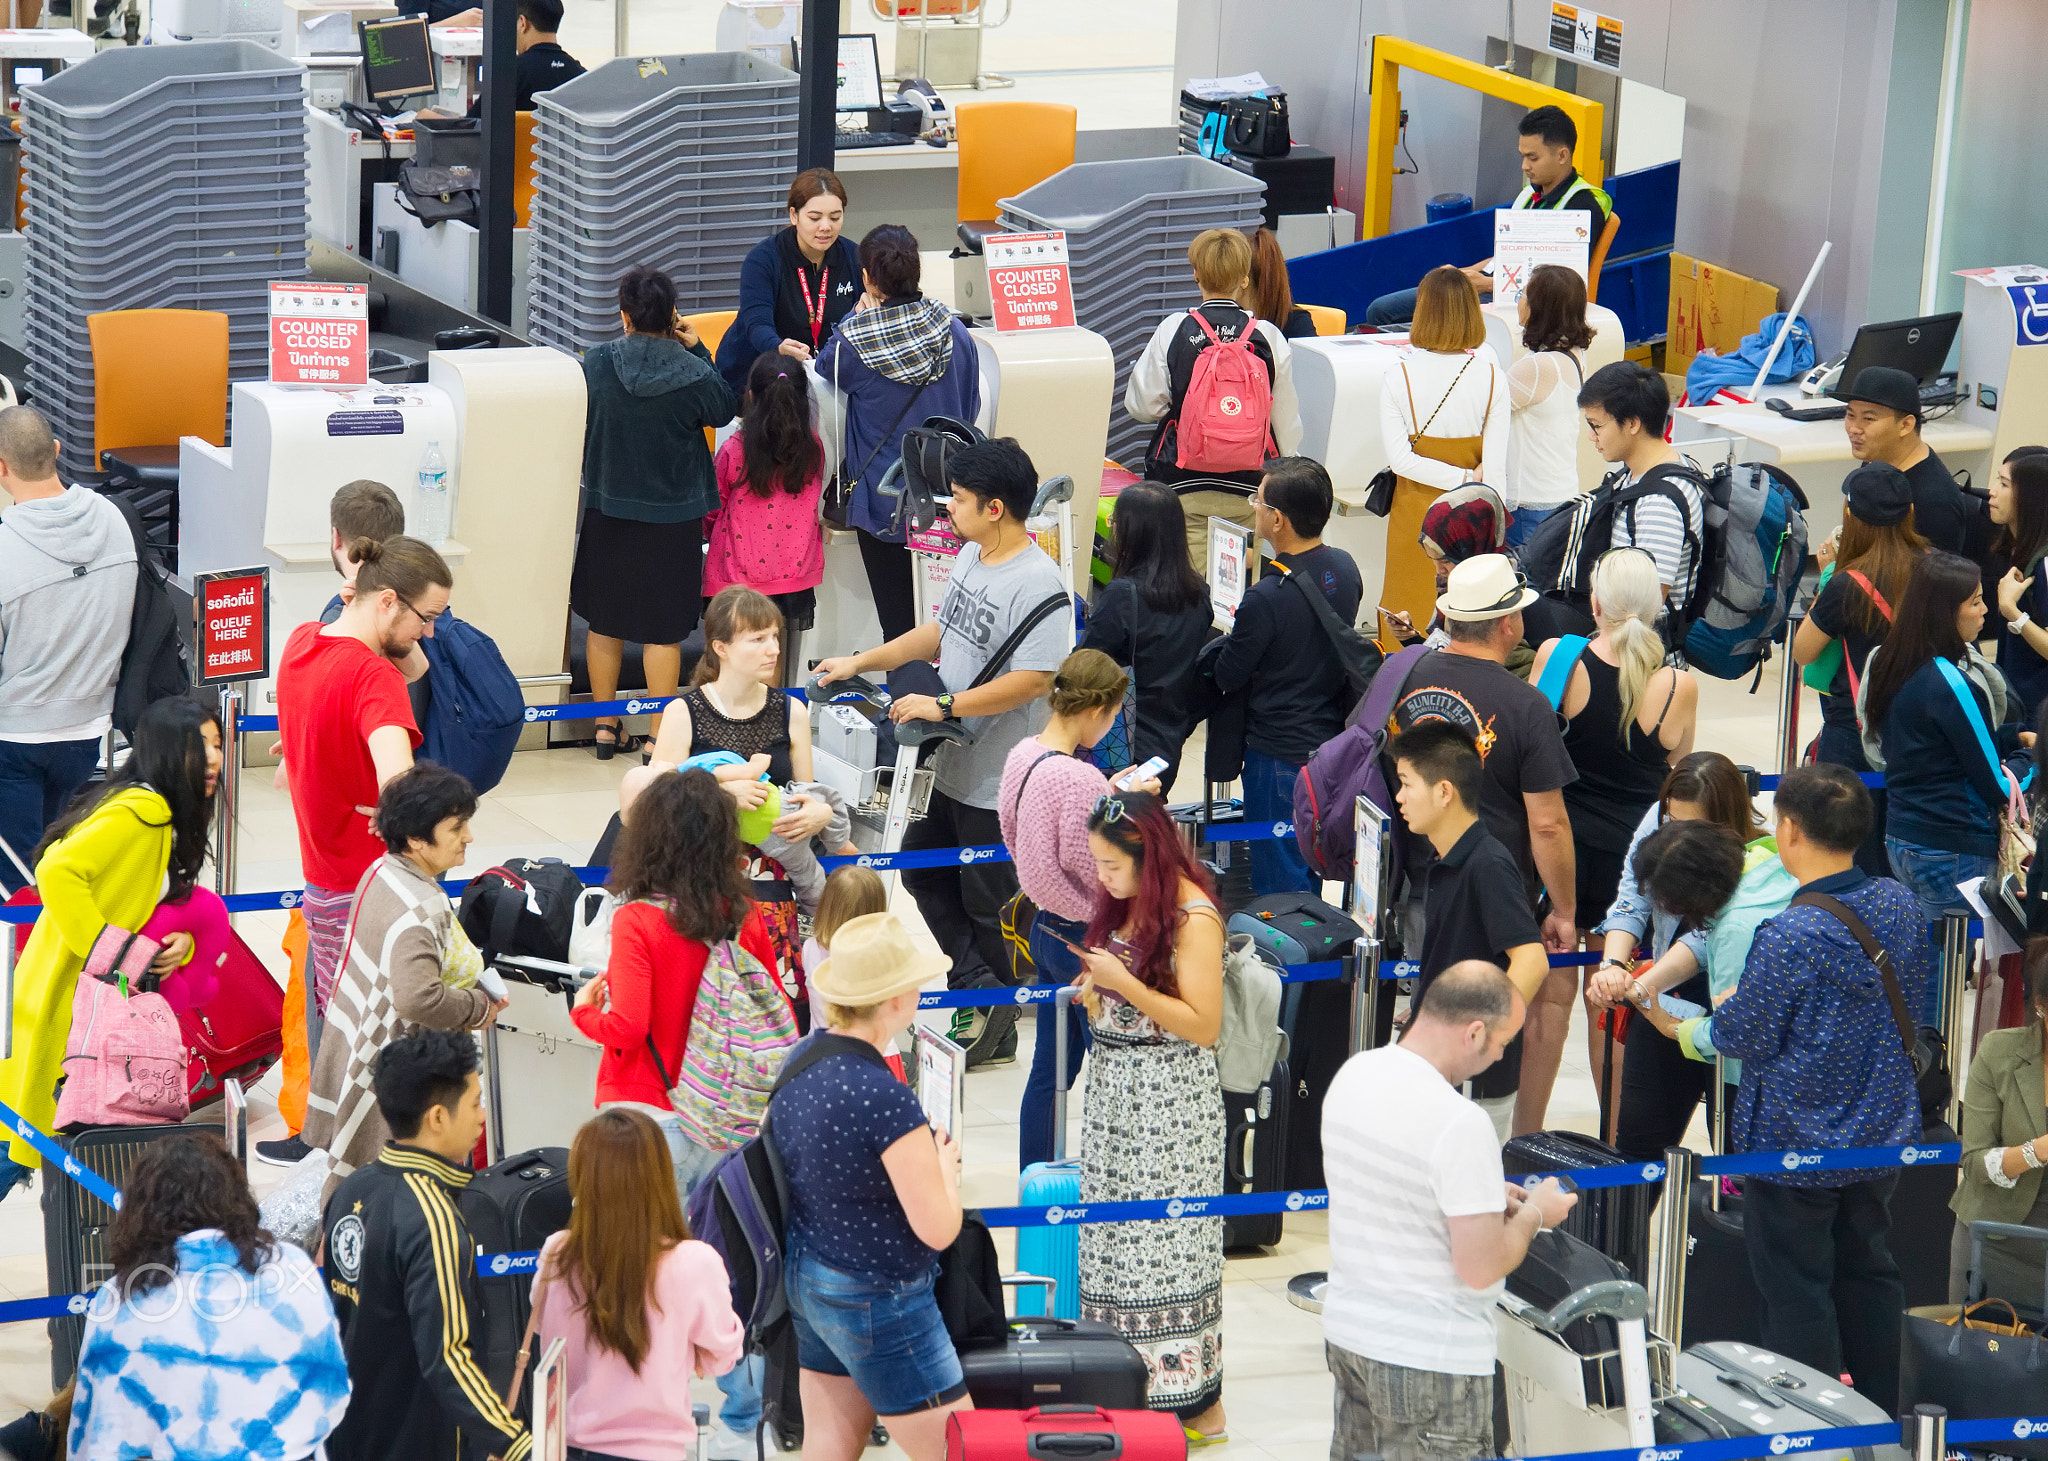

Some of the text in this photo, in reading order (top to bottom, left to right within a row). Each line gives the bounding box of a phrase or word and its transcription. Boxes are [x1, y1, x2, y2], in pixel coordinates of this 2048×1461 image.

[996, 268, 1061, 284] COUNTER
[1004, 282, 1057, 297] CLOSED
[1007, 298, 1058, 314] ปิดทำการ
[280, 321, 358, 336] COUNTER
[286, 335, 351, 349] CLOSED
[288, 352, 350, 367] ปิดทำการ
[207, 586, 254, 610] รอคิวที่นี่
[210, 615, 252, 630] QUEUE
[215, 628, 247, 642] HERE
[208, 648, 253, 666] 在此排队
[640, 702, 661, 710] AOT
[1406, 694, 1472, 725] SUNCITY H-D
[974, 850, 995, 858] AOT
[872, 858, 893, 866] AOT
[1030, 990, 1052, 998] AOT
[919, 997, 941, 1005] AOT
[1800, 1155, 1824, 1165] AOT
[1918, 1150, 1942, 1159] AOT
[1303, 1194, 1328, 1205] AOT
[1064, 1208, 1088, 1219] AOT
[1184, 1202, 1209, 1213] AOT
[510, 1256, 536, 1268] AOT
[2032, 1422, 2048, 1433] AO
[1789, 1436, 1814, 1448] AOT
[1657, 1450, 1683, 1461] AOT
